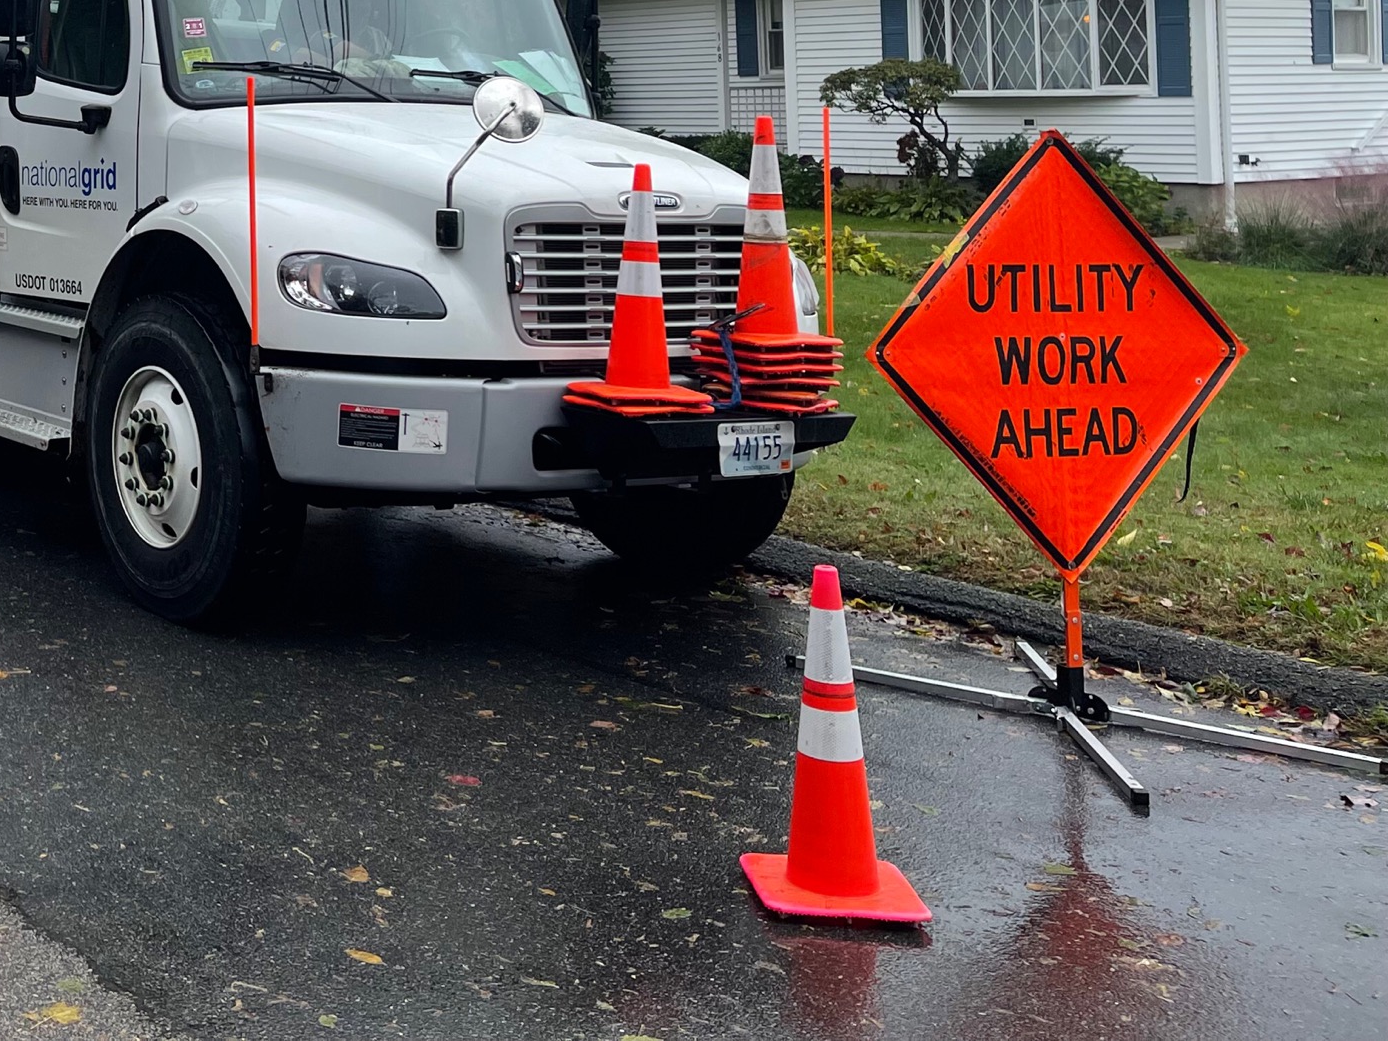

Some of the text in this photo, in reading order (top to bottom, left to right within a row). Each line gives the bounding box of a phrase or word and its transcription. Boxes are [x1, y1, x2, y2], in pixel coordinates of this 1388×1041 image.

[21, 157, 117, 196] nationalgrid
[22, 196, 118, 211] HERE WITH YOU. HERE FOR YOU.
[15, 273, 82, 295] USDOT 013664
[966, 263, 1144, 314] UTILITY
[994, 335, 1127, 386] WORK
[736, 424, 776, 434] Rhode Island
[991, 407, 1138, 459] AHEAD
[733, 435, 781, 461] 44155
